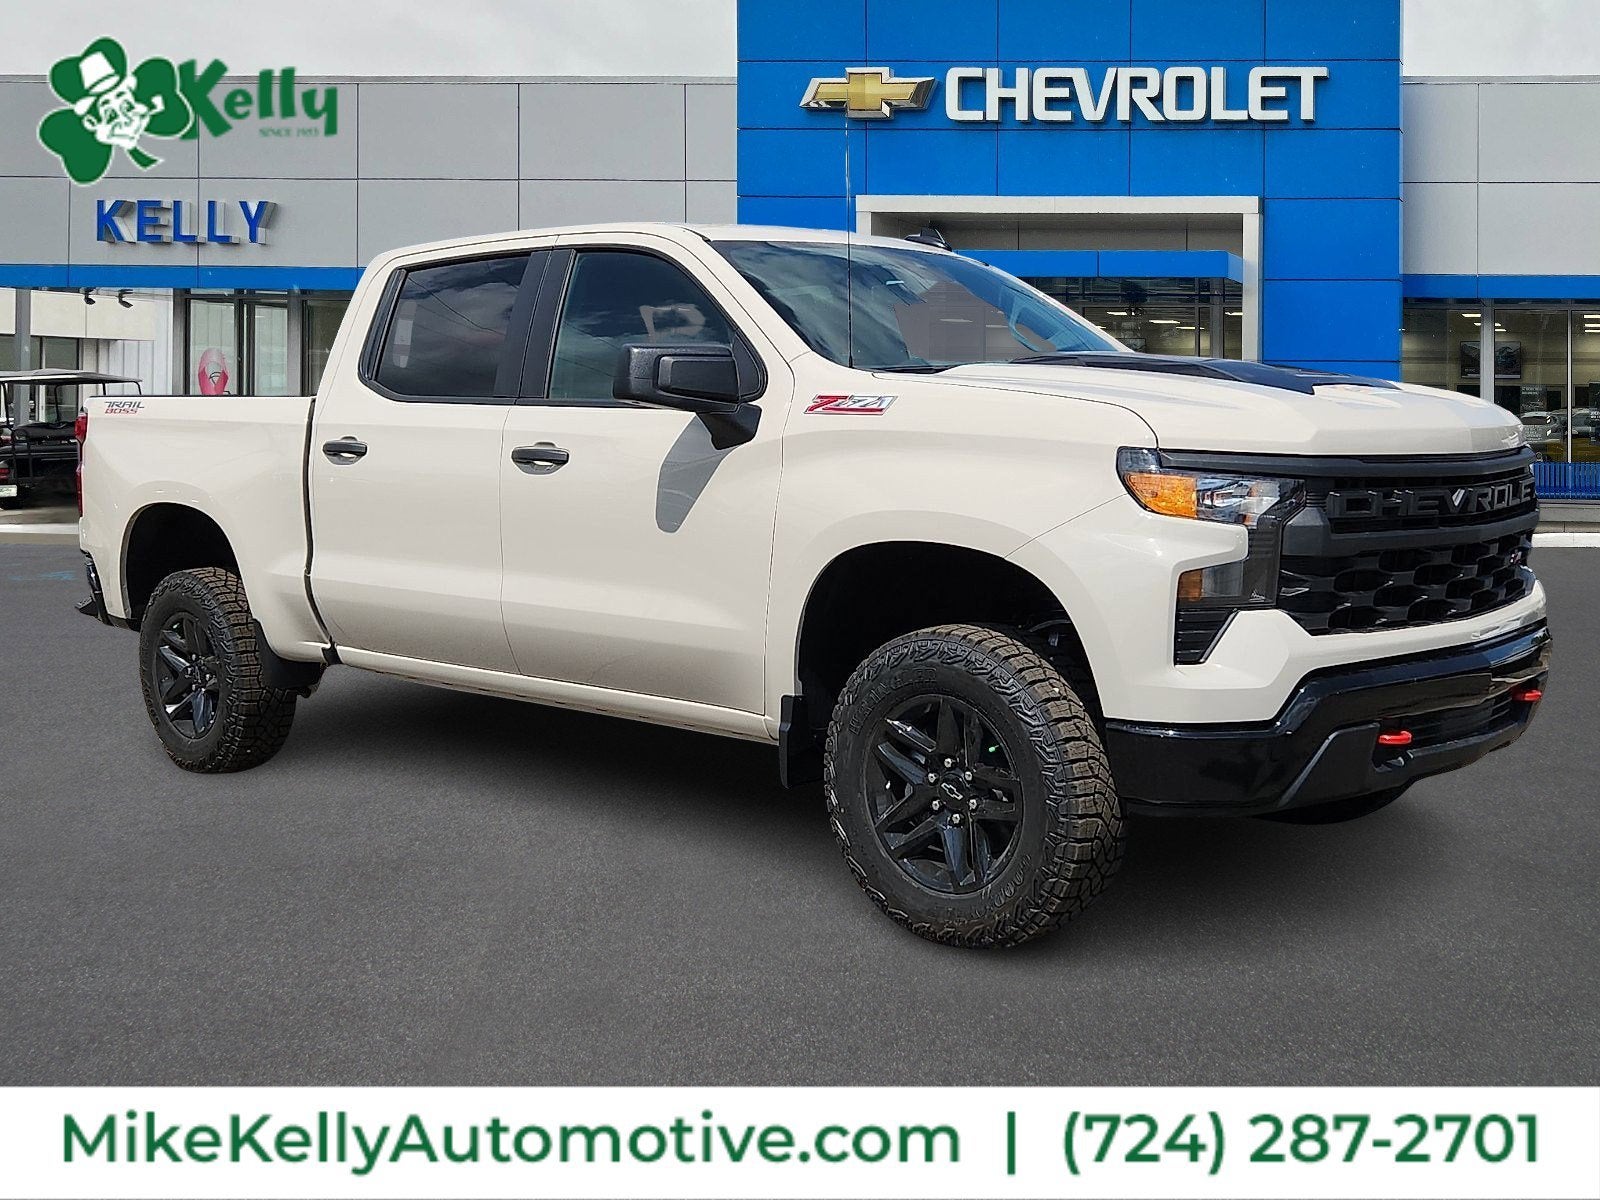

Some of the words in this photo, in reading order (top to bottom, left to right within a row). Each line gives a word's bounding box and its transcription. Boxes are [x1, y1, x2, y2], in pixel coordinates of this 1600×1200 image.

[945, 66, 1329, 123] CHEVROLET
[96, 199, 277, 245] KELLY
[104, 401, 145, 409] TRAIL
[1326, 476, 1535, 517] CHEVROLE
